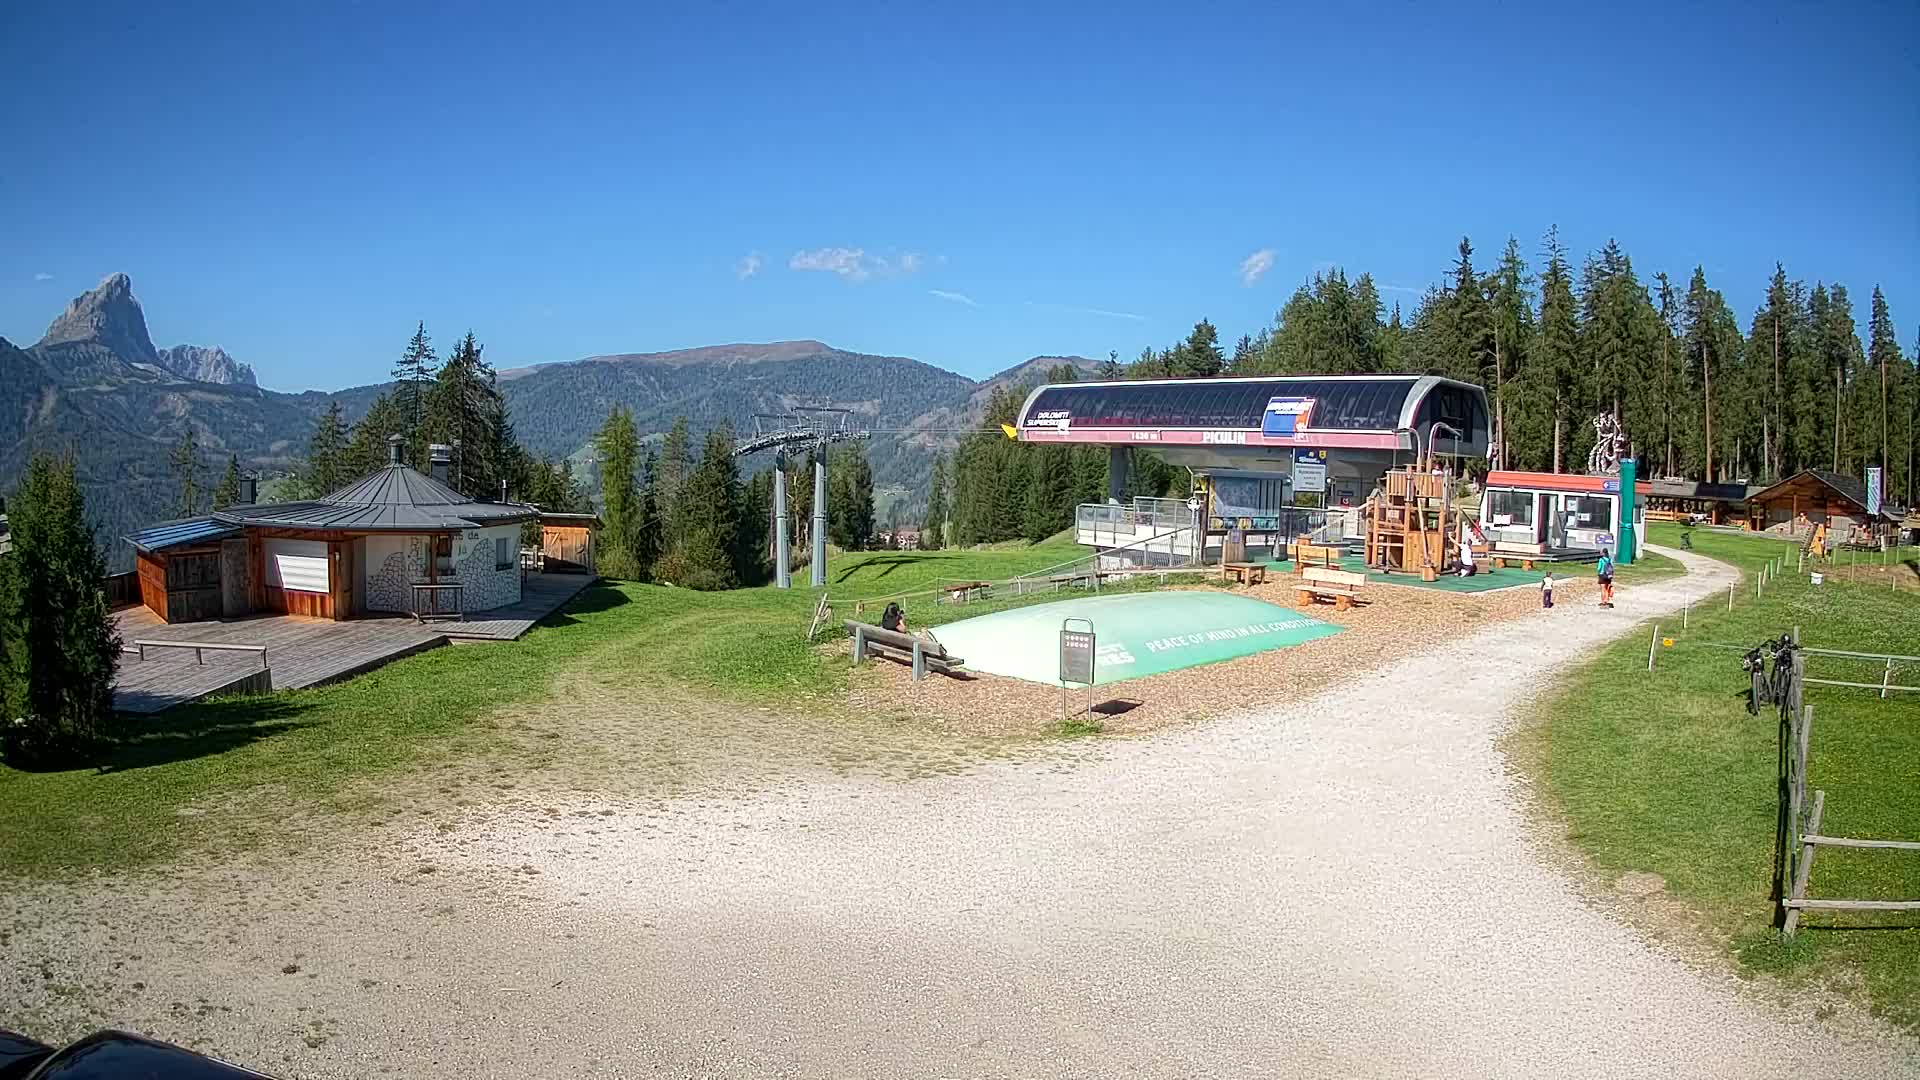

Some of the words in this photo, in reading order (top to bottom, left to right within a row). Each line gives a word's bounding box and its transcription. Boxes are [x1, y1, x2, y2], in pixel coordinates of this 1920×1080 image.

[1202, 431, 1246, 444] PICULIN
[1145, 635, 1190, 652] PEACE
[1190, 632, 1207, 645] OF
[1207, 628, 1236, 642] MIND
[1235, 626, 1251, 637] IN
[1251, 623, 1271, 635] ALL
